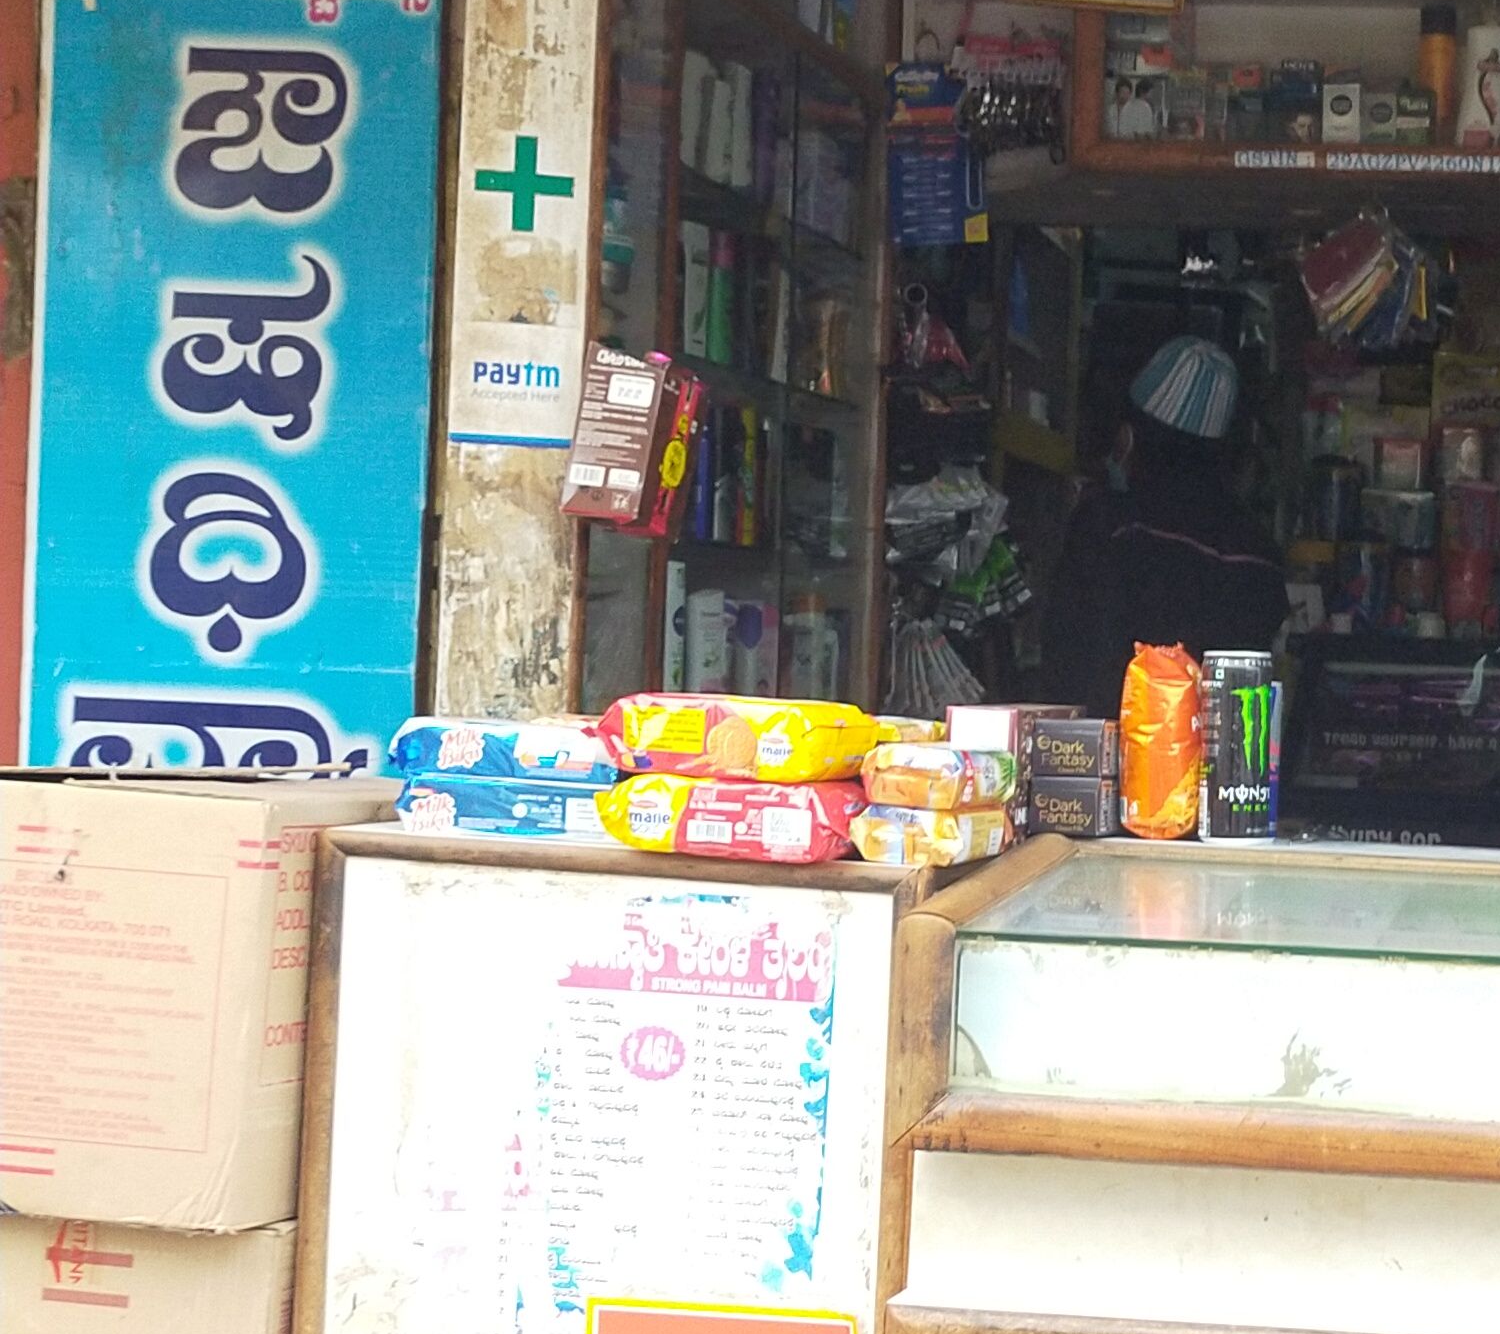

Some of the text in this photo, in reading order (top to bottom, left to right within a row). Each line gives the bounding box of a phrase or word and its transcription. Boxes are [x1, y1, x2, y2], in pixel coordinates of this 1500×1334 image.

[473, 360, 561, 389] paytm
[471, 387, 561, 403] Accepted Here
[444, 728, 482, 747] Milk
[1051, 739, 1085, 754] Dark
[1041, 751, 1096, 768] Fantasy
[1049, 798, 1084, 813] Dark
[628, 810, 671, 826] marie
[1038, 809, 1094, 827] Fantasy
[650, 976, 767, 998] STRONG PAIN BALM
